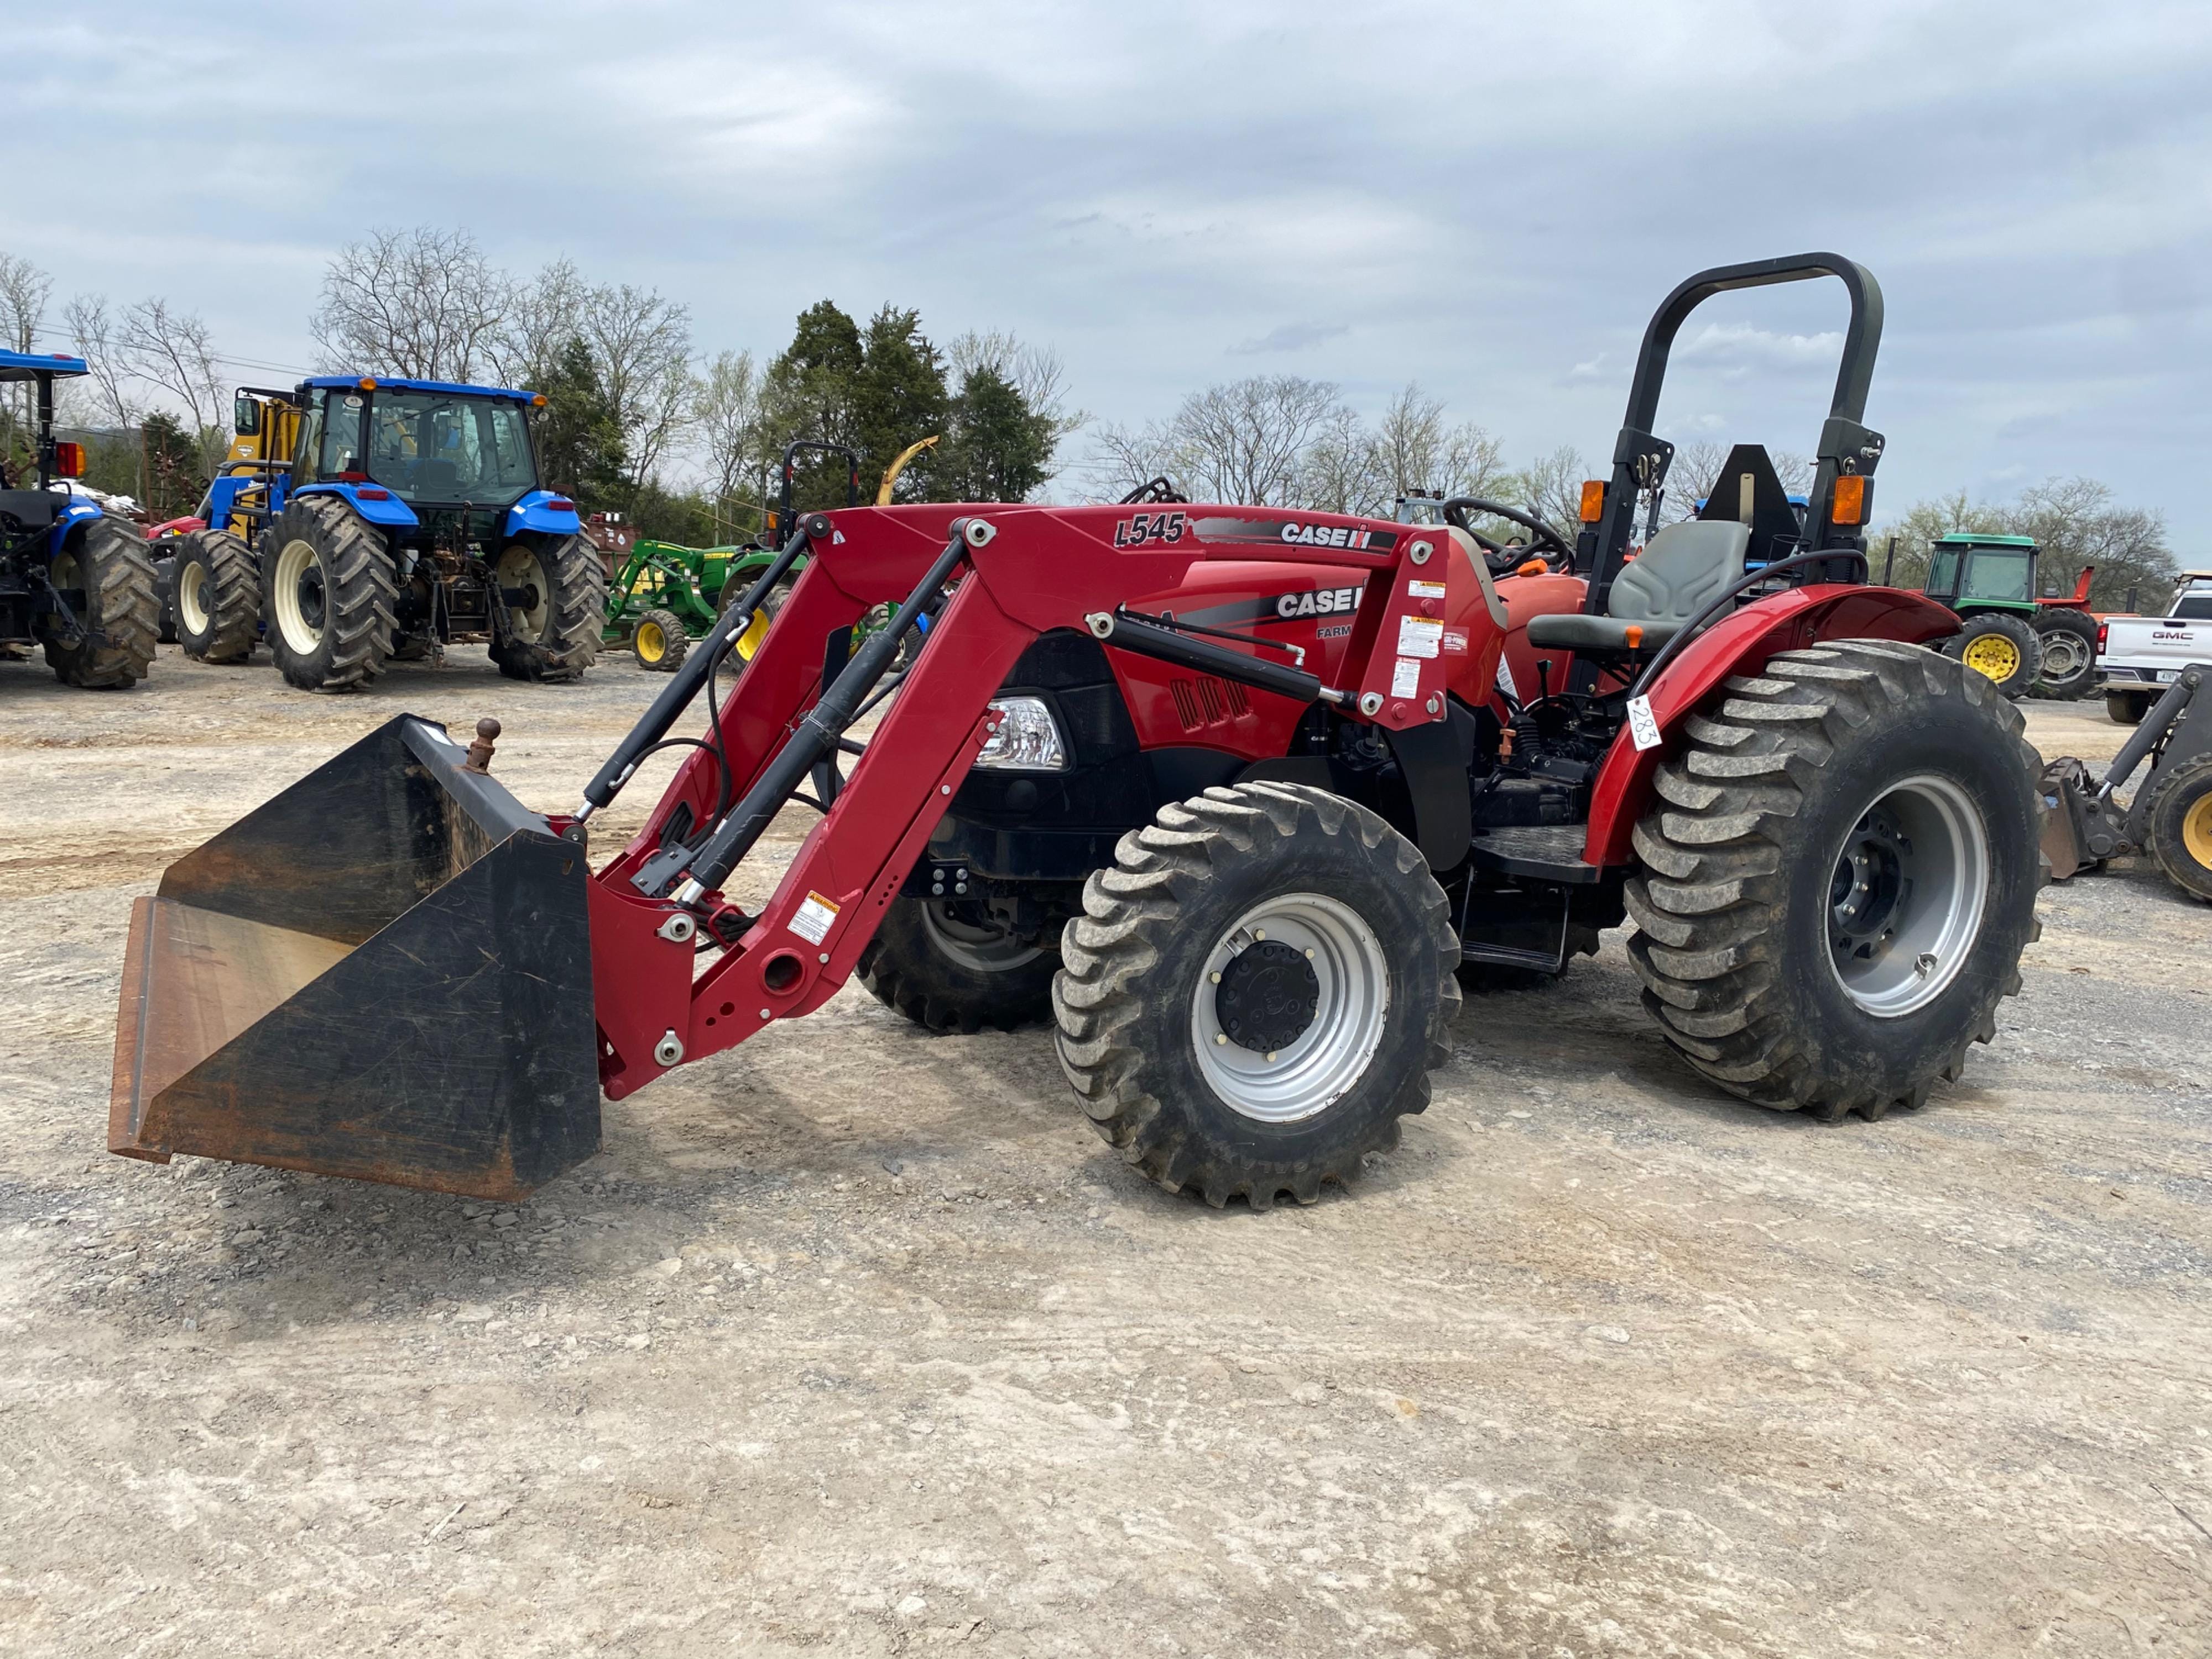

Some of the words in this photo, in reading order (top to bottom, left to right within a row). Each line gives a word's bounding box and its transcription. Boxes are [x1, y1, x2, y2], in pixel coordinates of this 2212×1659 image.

[1114, 512, 1186, 546] L545
[1281, 523, 1348, 547] CASE
[1278, 588, 1352, 618] CASE
[1317, 624, 1352, 639] FARM
[2152, 632, 2194, 640] GMC
[1632, 707, 1657, 744] 283
